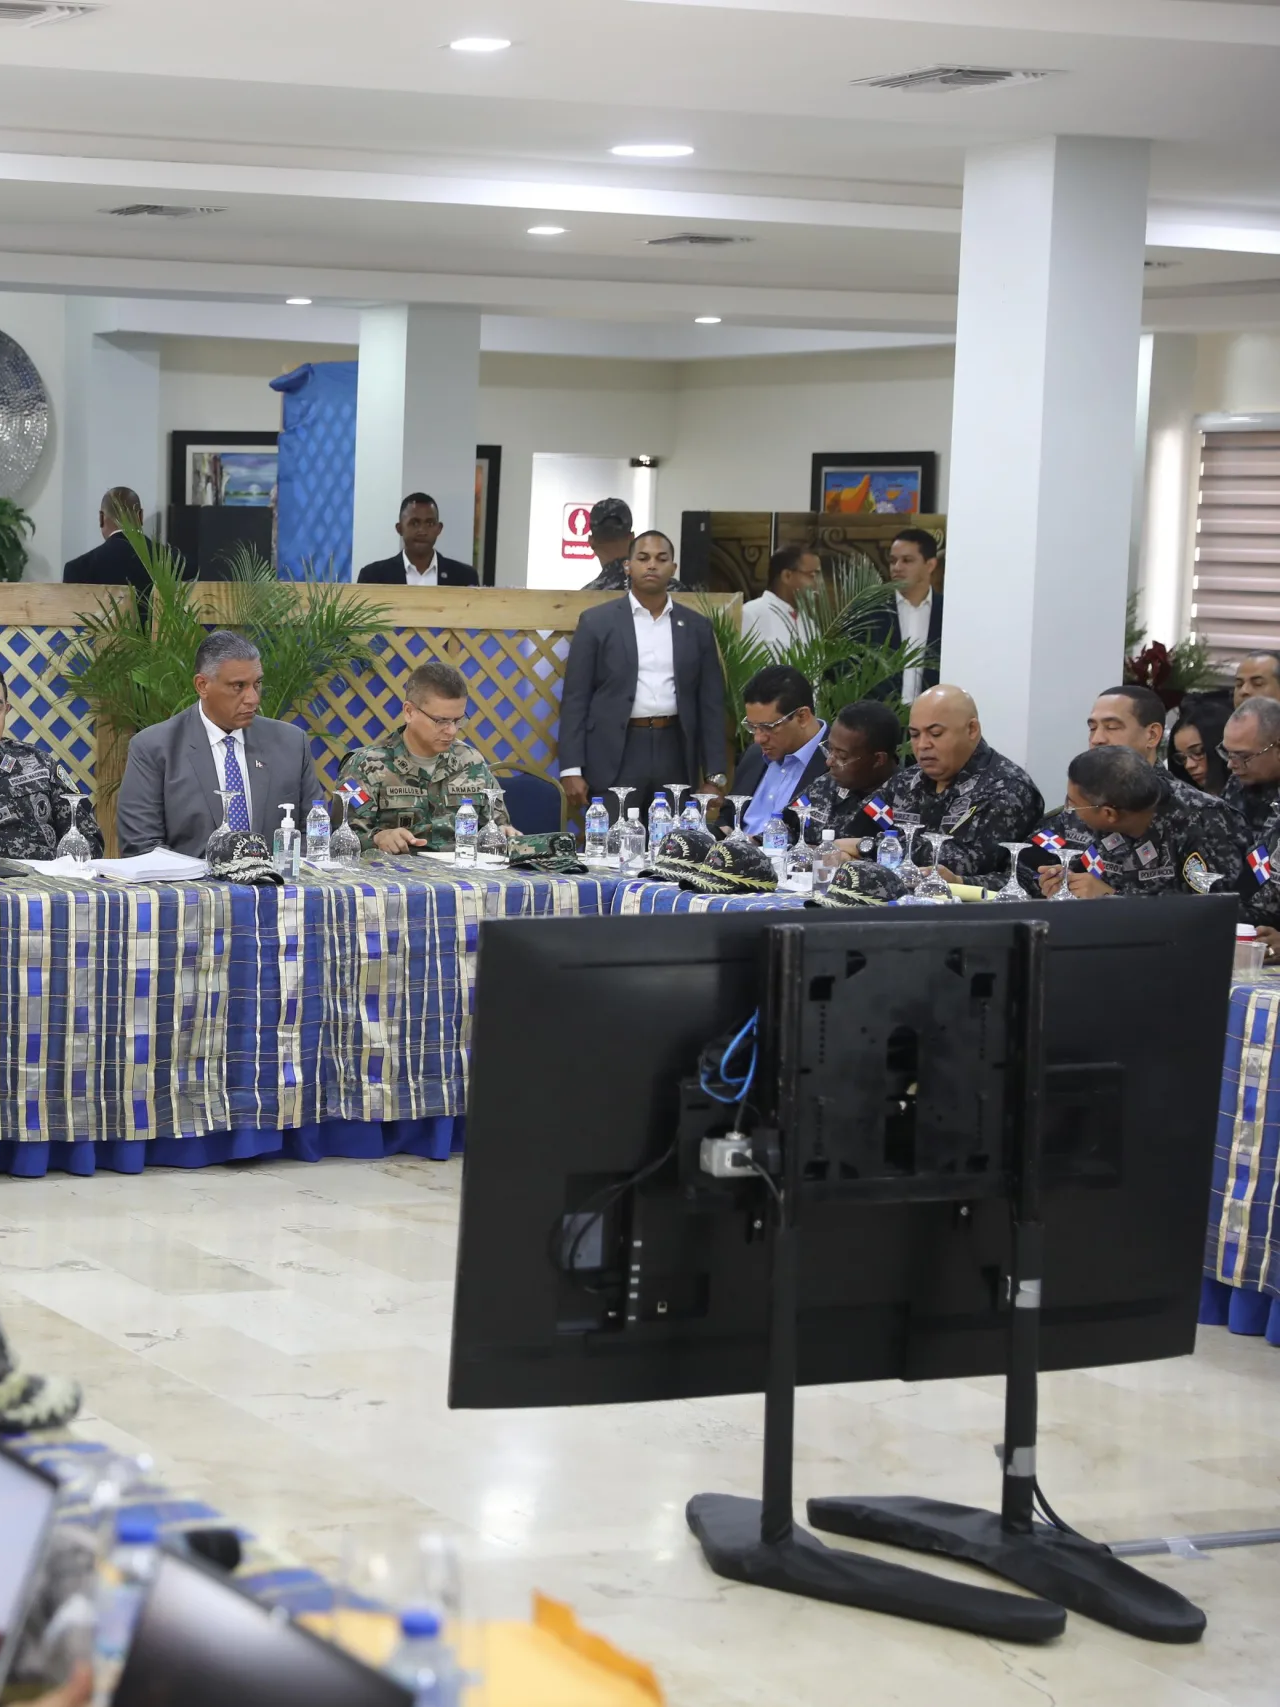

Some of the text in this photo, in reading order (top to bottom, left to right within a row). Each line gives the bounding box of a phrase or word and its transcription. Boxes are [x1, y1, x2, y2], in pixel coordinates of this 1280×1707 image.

[389, 787, 415, 795] MORILLO
[233, 837, 249, 860] POLICIA
[670, 833, 690, 857] NACIONAL
